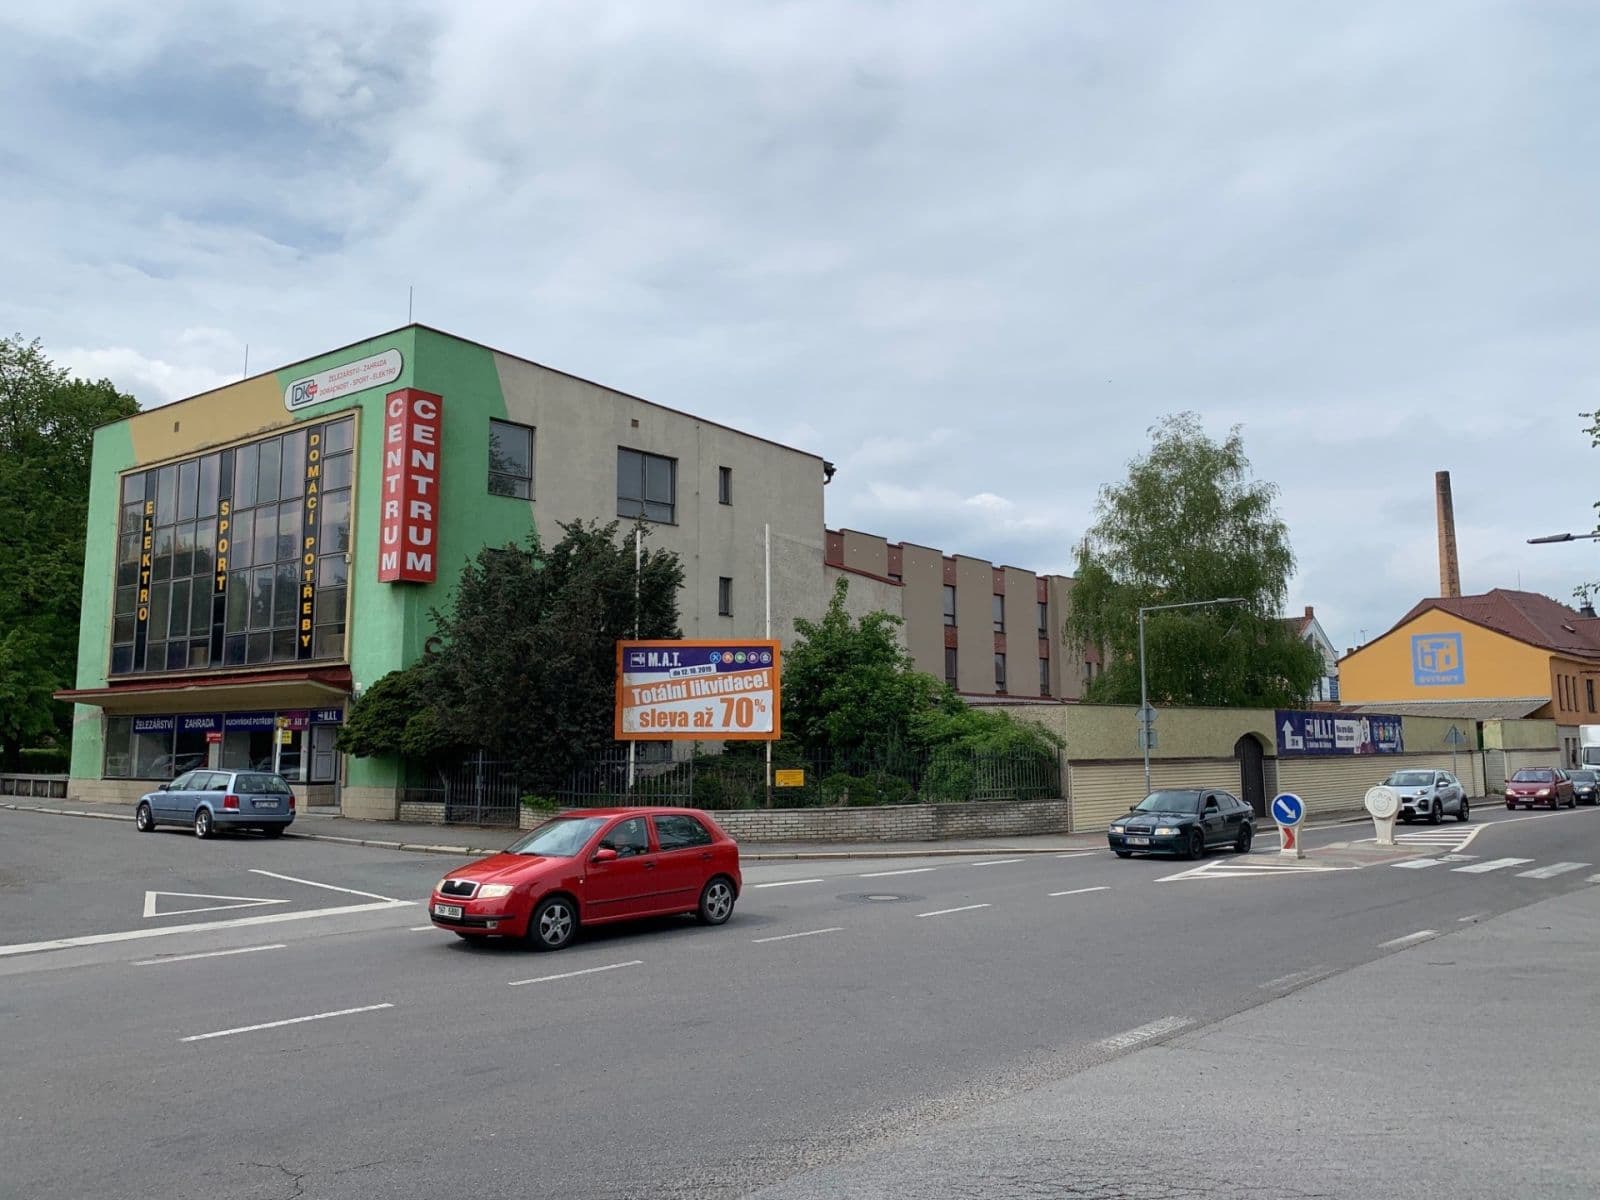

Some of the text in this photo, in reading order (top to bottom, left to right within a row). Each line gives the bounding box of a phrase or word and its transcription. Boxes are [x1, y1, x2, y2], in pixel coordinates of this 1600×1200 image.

[352, 375, 369, 386] SPORT
[372, 366, 397, 381] ELEKTRO
[363, 359, 388, 373] ZAHRADA
[381, 397, 404, 571] CENTRUM
[406, 398, 437, 573] CENTRUM
[216, 501, 230, 591] SPORT
[138, 500, 154, 621] ELEKTRO
[647, 651, 682, 667] M.A.T.
[632, 671, 769, 704] Totální likvidace!
[135, 717, 174, 730] ŽELEZÁŘSTVÍ
[184, 718, 215, 729] ZAHRADA
[639, 708, 689, 727] sleva
[693, 707, 714, 727] až
